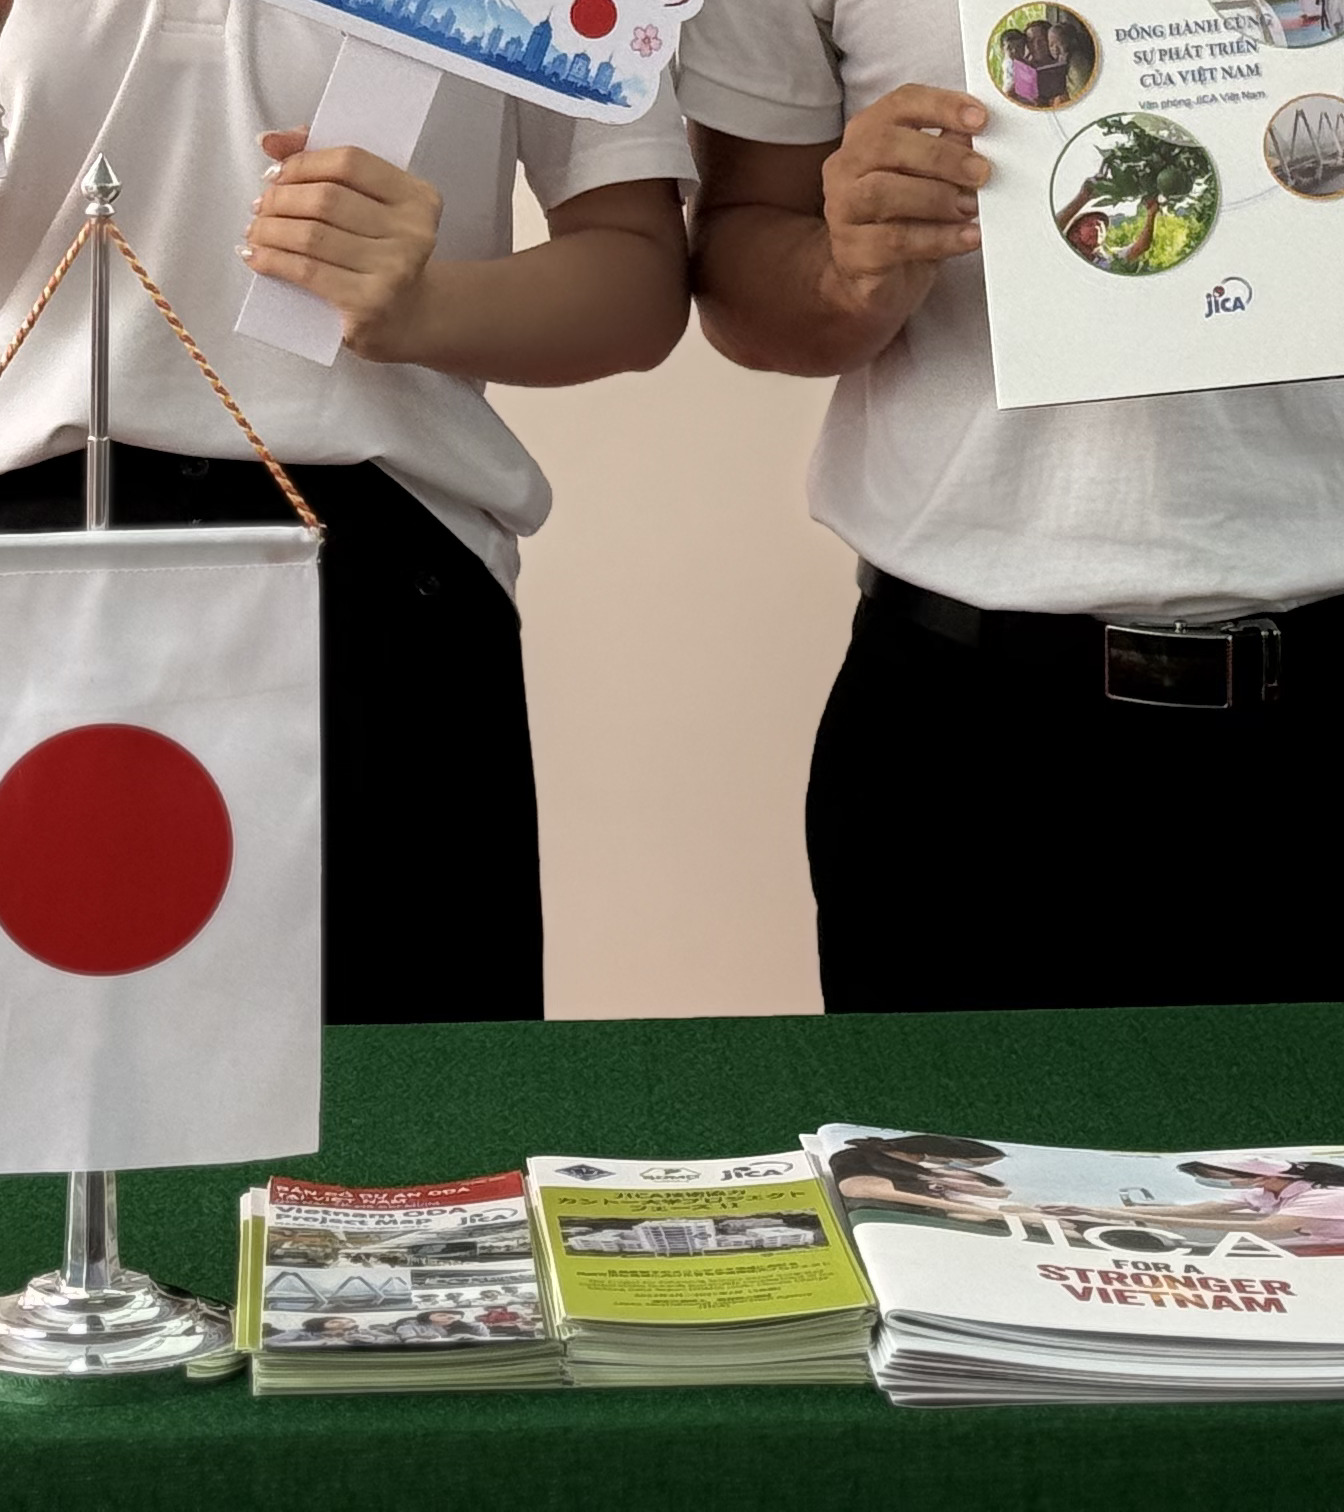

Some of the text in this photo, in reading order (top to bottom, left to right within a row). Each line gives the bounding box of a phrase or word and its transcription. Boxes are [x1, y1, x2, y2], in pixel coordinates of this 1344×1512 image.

[1168, 17, 1219, 37] HÀNH
[1133, 48, 1156, 65] SỰ
[1158, 43, 1205, 62] PHÁT
[1177, 65, 1218, 85] VIỆT
[1221, 62, 1261, 81] NAM
[276, 1205, 468, 1220] Vietnam ODA
[276, 1213, 369, 1227] Project
[375, 1216, 433, 1227] Map
[1112, 1258, 1206, 1275] FOR A
[1035, 1263, 1299, 1297] STRONGER
[1060, 1283, 1289, 1314] VIETNAM
